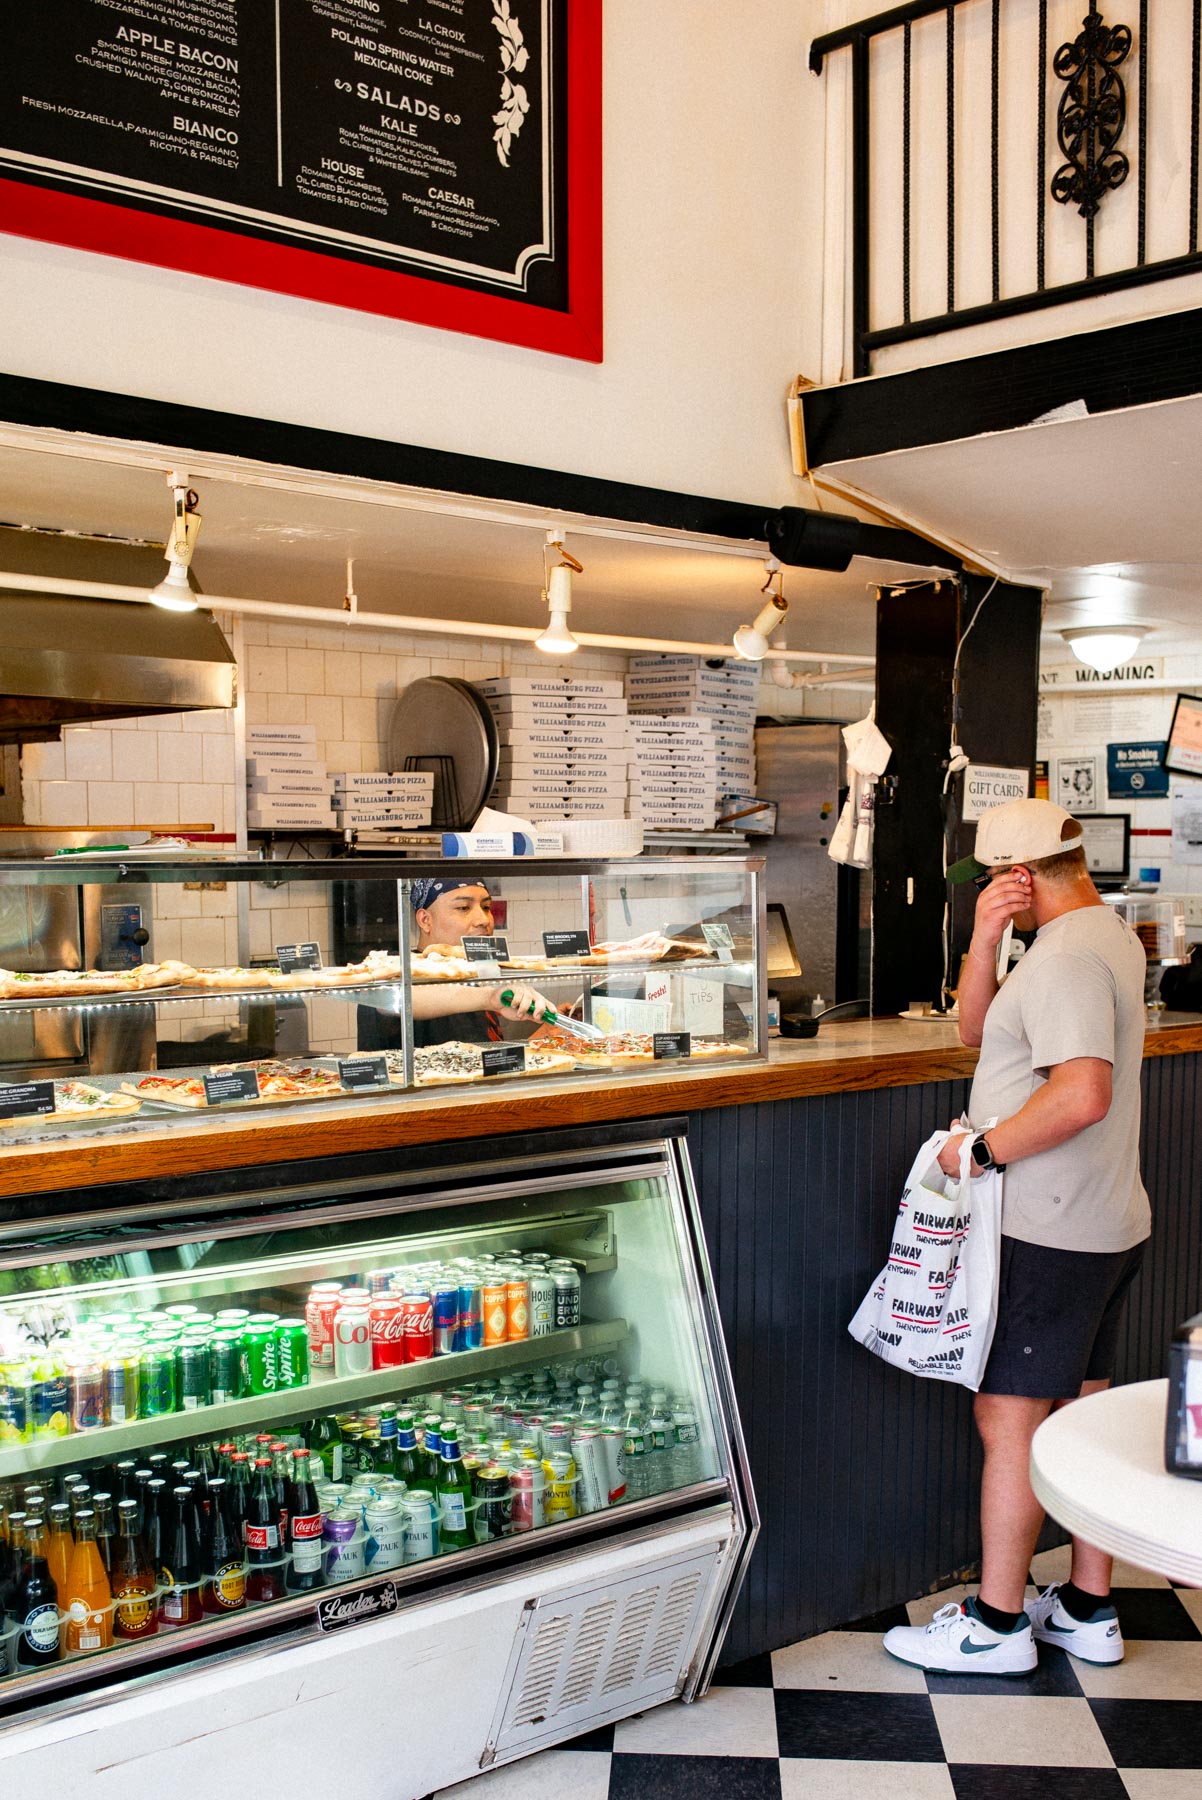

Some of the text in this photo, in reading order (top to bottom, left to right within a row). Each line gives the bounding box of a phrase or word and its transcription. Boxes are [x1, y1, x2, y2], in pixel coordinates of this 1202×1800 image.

[128, 0, 238, 36] ARMIGIANO-REGGIANO,
[312, 5, 378, 33] GRAPEFRUIT, LEMON
[451, 5, 463, 15] ALE
[161, 17, 168, 25] &
[168, 18, 206, 35] TOMATO
[208, 32, 238, 46] SAUCE
[399, 27, 431, 44] COCONUT,
[419, 18, 466, 43] LA CROIX
[116, 26, 238, 74] APPLE BACON
[331, 28, 454, 77] POLAND SPRING WATER
[91, 47, 240, 97] PARMIGIANO-REGGIANO, BACON,
[97, 40, 240, 89] SMOKED FRESH MOZZARELLA,
[355, 51, 433, 85] MEXICAN COKE
[75, 54, 240, 108] CRUSHED WALNUTS, GORGONZOLA,
[160, 89, 240, 118] APPLE & PARSLEY
[357, 83, 440, 120] SALADS
[22, 96, 239, 159] FRESH MOZZARELLA, PARMIGIANO-REGGIANO,
[173, 116, 239, 145] BIANCO
[359, 124, 396, 140] MARINATED
[381, 115, 418, 137] KALE
[150, 140, 188, 156] RICOTTA
[200, 152, 239, 169] PARSLEY
[339, 128, 457, 169] ROMA TOMATOES, KALE, CUCUMBERS,
[339, 138, 351, 146] OIL
[352, 141, 374, 153] CURED
[376, 148, 397, 161] BLACK
[399, 156, 423, 169] OLIVES,
[302, 166, 384, 195] ROMAINE, CUCUMBERS,
[322, 157, 365, 179] HOUSE
[375, 157, 396, 168] WHITE
[398, 163, 429, 178] BALSAMIC
[296, 175, 389, 206] OIL CURED BLACK OLIVES,
[297, 185, 336, 202] TOMATOES
[344, 198, 359, 208] RED
[361, 202, 388, 215] ONIONS
[402, 193, 435, 209] ROMAINE,
[428, 188, 475, 209] CAESAR
[414, 206, 489, 232] PARMIGIANO-REGGIANO
[438, 222, 473, 238] CROUTONS
[635, 659, 676, 667] WILLIAMSBURG
[531, 684, 583, 692] WILLIAMSBURG
[696, 707, 735, 716] WILLIAMSBURG
[969, 782, 1023, 797] GIFT CARDS
[351, 814, 403, 822] WILLIAMSBURG
[913, 1211, 956, 1229] FAIRWA
[558, 1295, 579, 1305] UND
[558, 1305, 579, 1315] ERW
[893, 1299, 943, 1317] FAIRWAY
[557, 1316, 579, 1325] OOD
[896, 1321, 938, 1334] THENYCWAY
[263, 1343, 276, 1390] Sprite
[278, 1337, 292, 1386] Sprite
[322, 1593, 380, 1620] Leader
